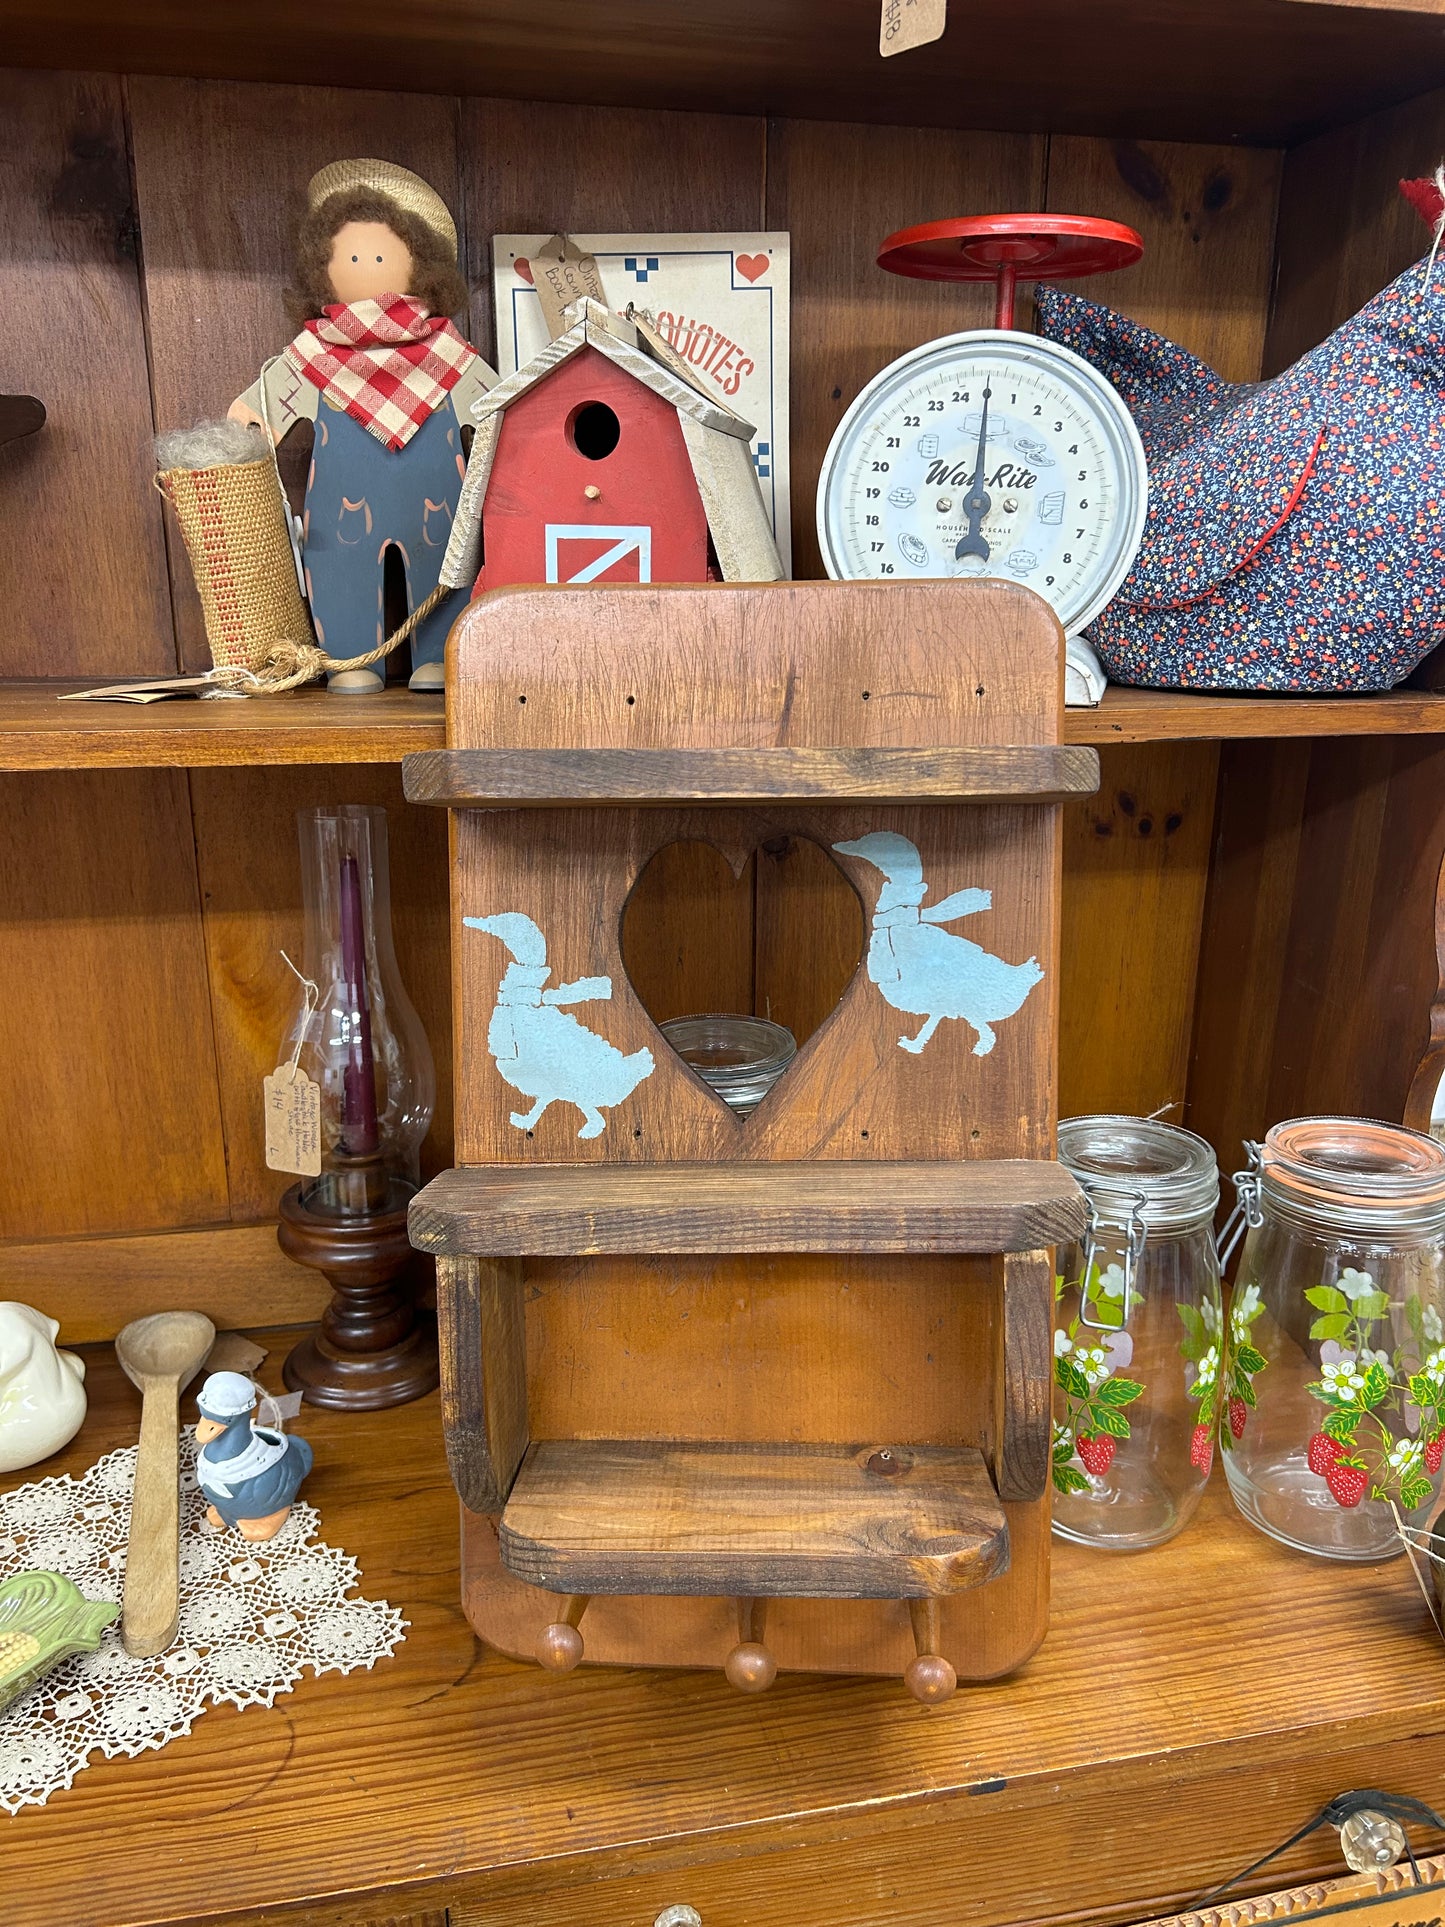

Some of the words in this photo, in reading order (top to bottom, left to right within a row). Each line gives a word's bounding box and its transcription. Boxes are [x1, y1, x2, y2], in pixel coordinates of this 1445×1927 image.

[564, 266, 583, 300] Coun
[656, 311, 754, 396] QUOTES
[951, 391, 970, 403] 24
[1010, 393, 1017, 404] 1
[928, 400, 945, 412] 23
[1033, 404, 1042, 416] 2
[903, 415, 921, 427] 22
[1054, 421, 1063, 433] 3
[886, 437, 901, 448] 21
[1068, 444, 1078, 455] 4
[872, 461, 890, 473] 20
[1077, 470, 1086, 482] 5
[866, 488, 881, 499] 19
[1079, 498, 1088, 510] 6
[866, 515, 880, 527] 18
[936, 525, 984, 533] HOUSEHD
[1075, 528, 1085, 540] 7
[871, 542, 884, 553] 17
[1062, 553, 1072, 565] 8
[880, 563, 894, 575] 16
[1045, 575, 1055, 588] 9
[271, 1088, 286, 1111] $14
